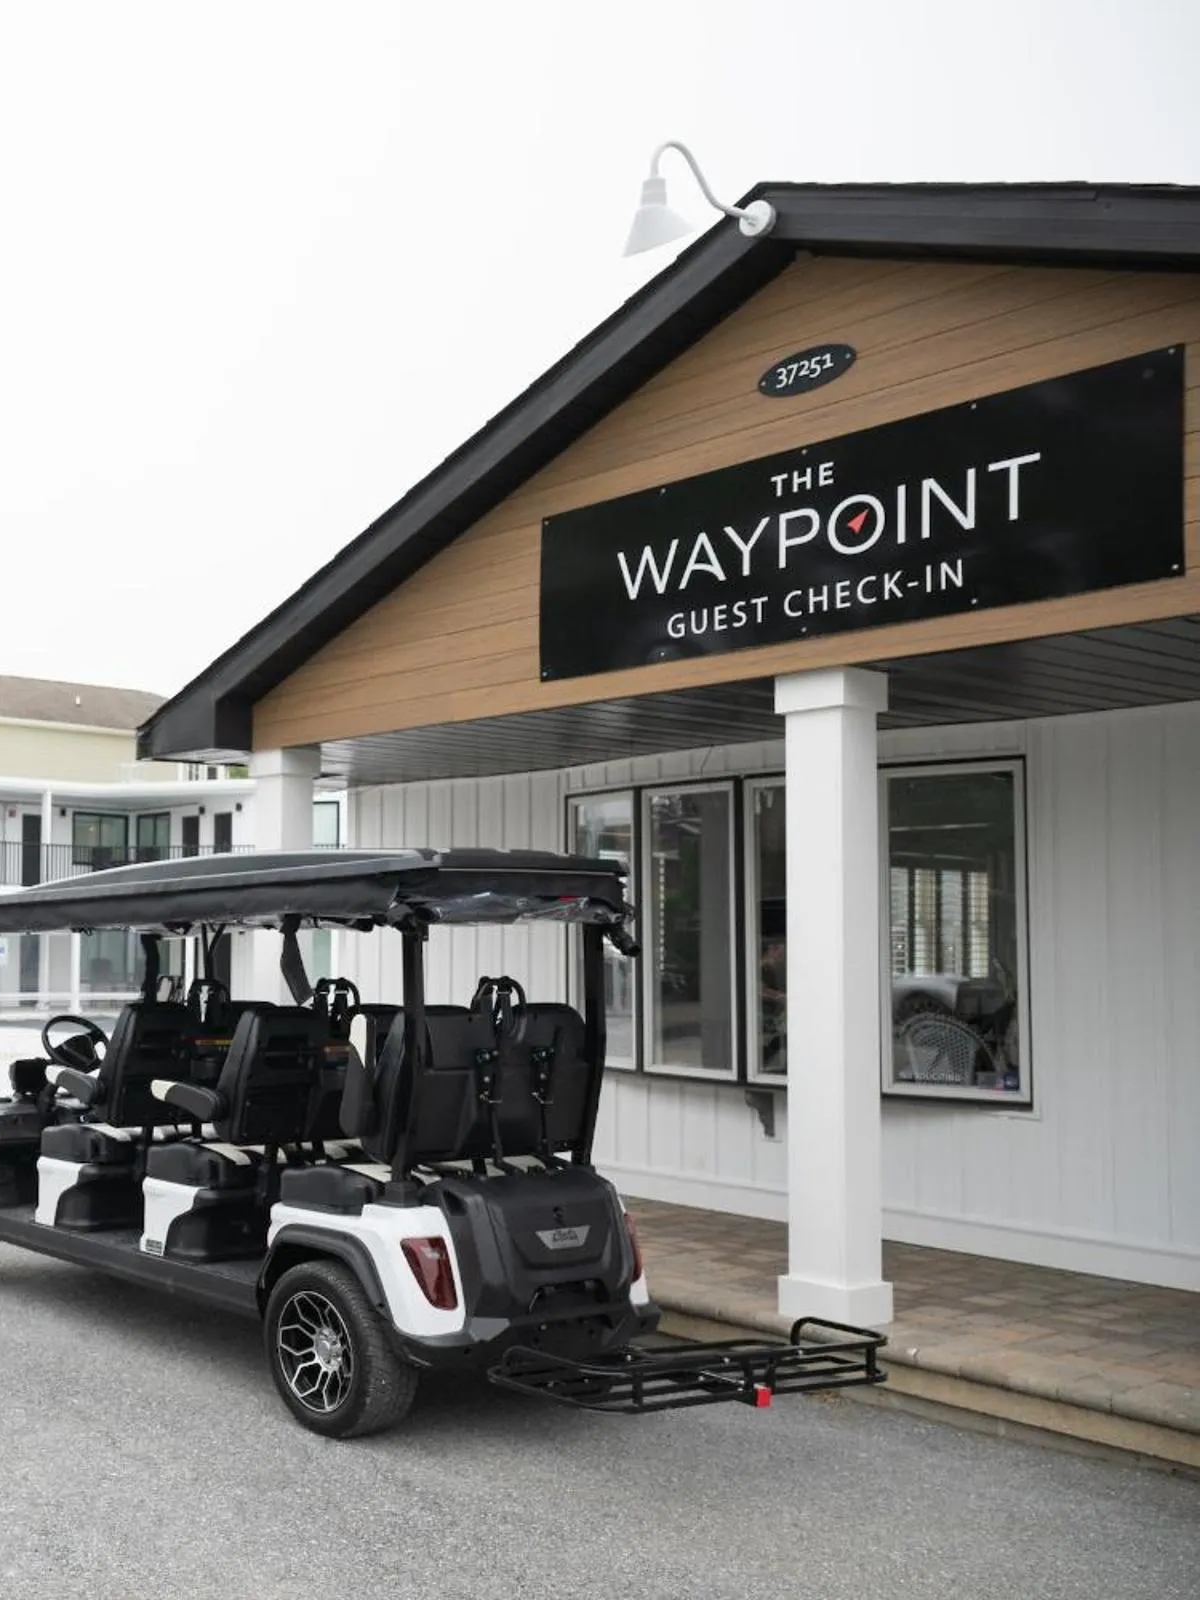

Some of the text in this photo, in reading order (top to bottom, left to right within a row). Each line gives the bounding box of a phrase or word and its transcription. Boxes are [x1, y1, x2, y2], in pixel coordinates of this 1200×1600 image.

[776, 353, 834, 389] 37251
[771, 462, 833, 497] THE
[616, 453, 1041, 601] WAYPOINT
[667, 560, 963, 639] GUEST CHECK-IN
